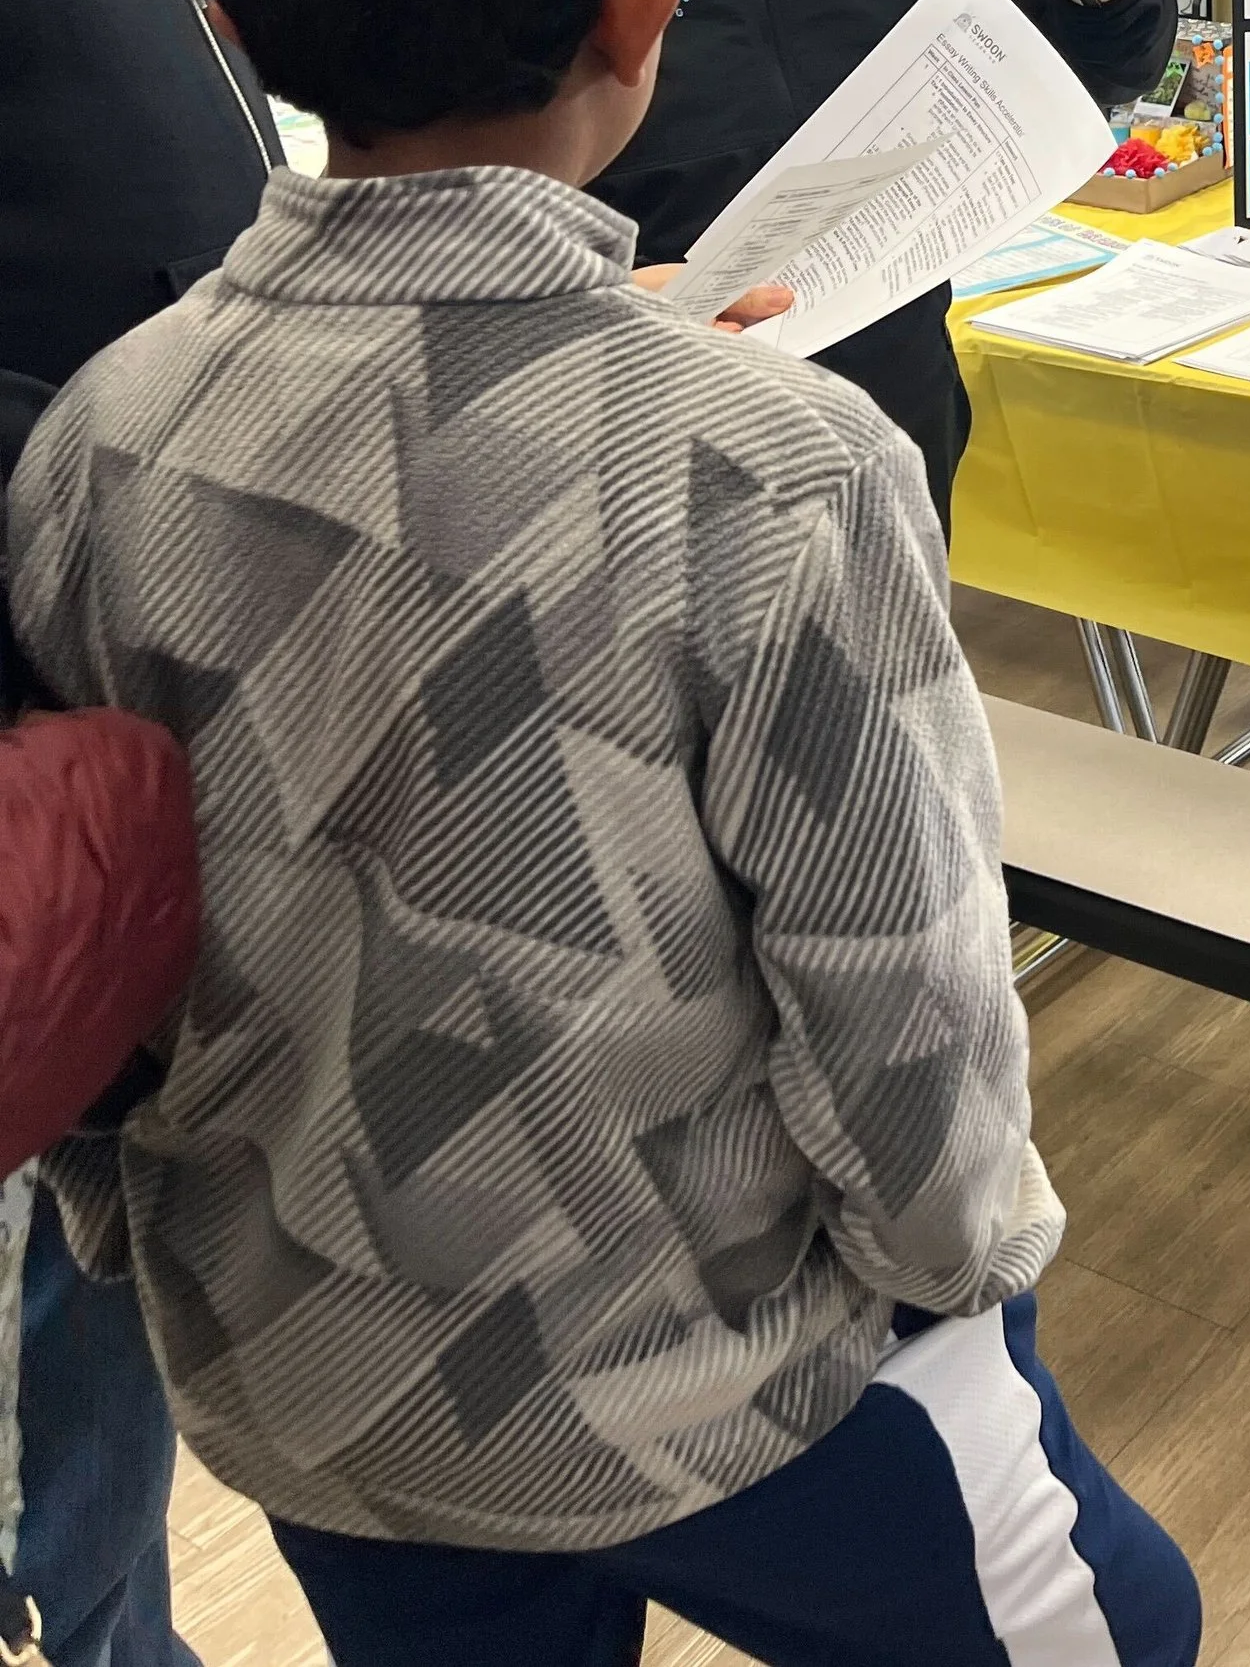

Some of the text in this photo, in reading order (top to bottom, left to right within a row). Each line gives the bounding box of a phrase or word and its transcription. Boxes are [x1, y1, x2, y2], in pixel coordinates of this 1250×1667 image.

[936, 33, 959, 58] Essay
[958, 55, 980, 84] Writing
[980, 80, 998, 102] Skills
[971, 24, 1006, 62] SWOON
